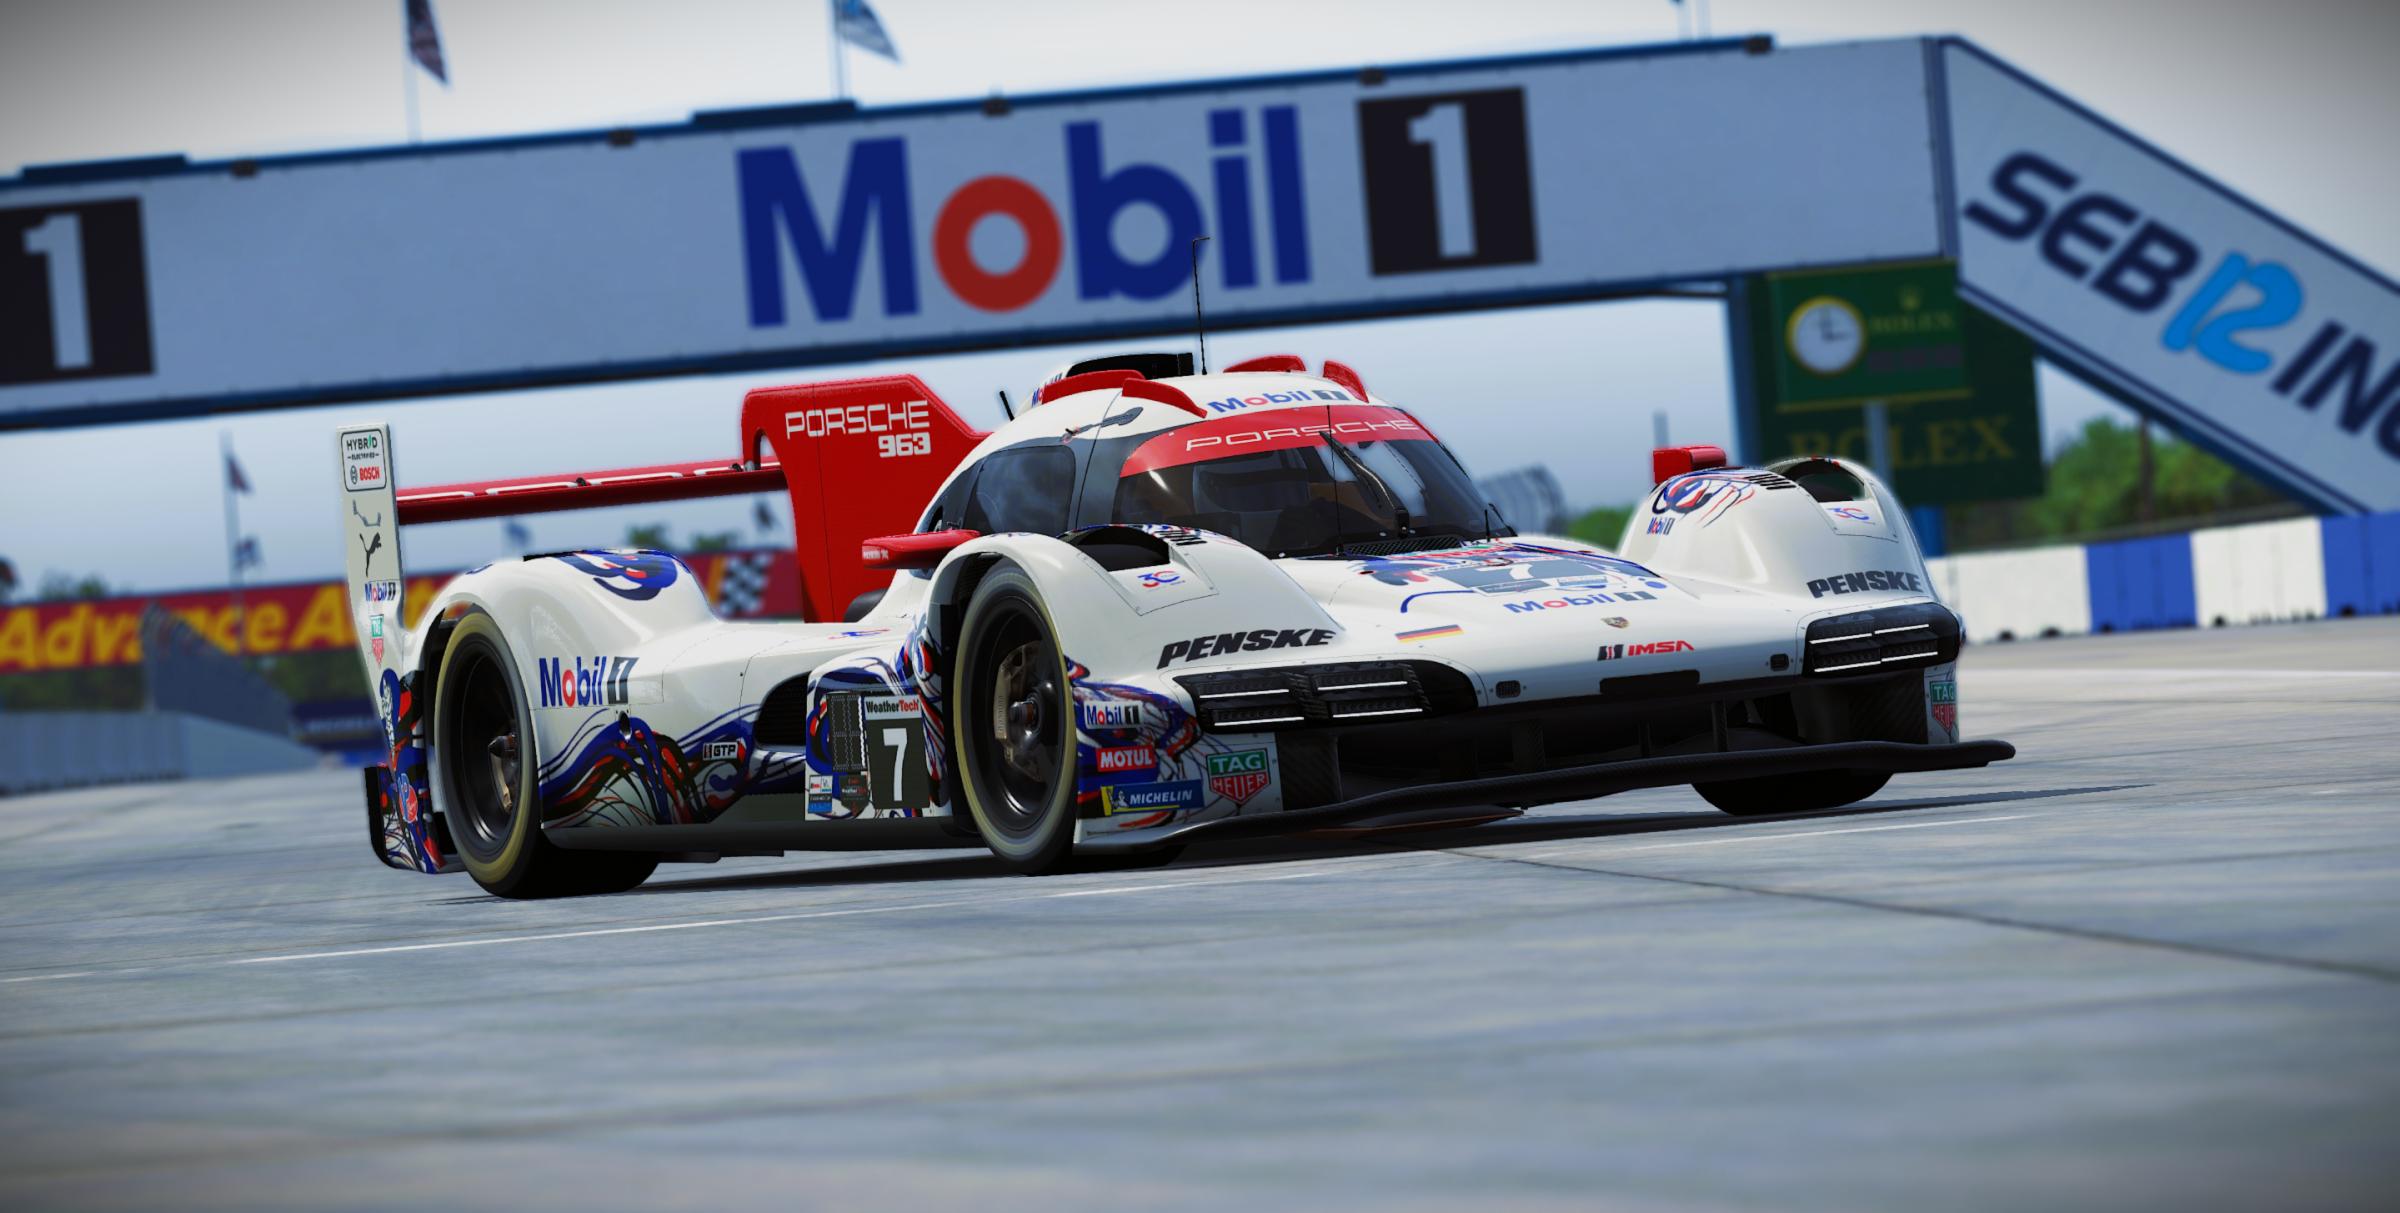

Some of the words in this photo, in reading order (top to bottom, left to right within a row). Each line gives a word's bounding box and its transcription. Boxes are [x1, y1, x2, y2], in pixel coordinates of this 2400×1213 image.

[735, 103, 1312, 329] Mobil
[1408, 102, 1478, 260] 1
[22, 212, 93, 370] 1
[1208, 390, 1313, 413] Mobil
[785, 400, 930, 440] PORSCHE
[346, 434, 378, 451] HYBRID
[878, 432, 931, 458] 963
[1186, 419, 1419, 451] PORSCHE
[359, 466, 380, 481] BOSCH
[365, 581, 388, 602] Mobil
[1806, 571, 1923, 598] PENSKE
[1503, 593, 1616, 613] Mobil
[1156, 628, 1336, 670] PENSKE
[1628, 640, 1695, 656] IMSA
[539, 656, 607, 708] Mobil
[866, 699, 919, 714] WeatherTech
[1086, 704, 1122, 726] Mobil
[714, 744, 736, 757] GTP
[1100, 750, 1152, 769] MOTUL
[883, 728, 907, 801] 7
[1213, 755, 1262, 774] TAG
[1130, 790, 1193, 805] MICHELIN
[1213, 773, 1266, 801] HEUER
